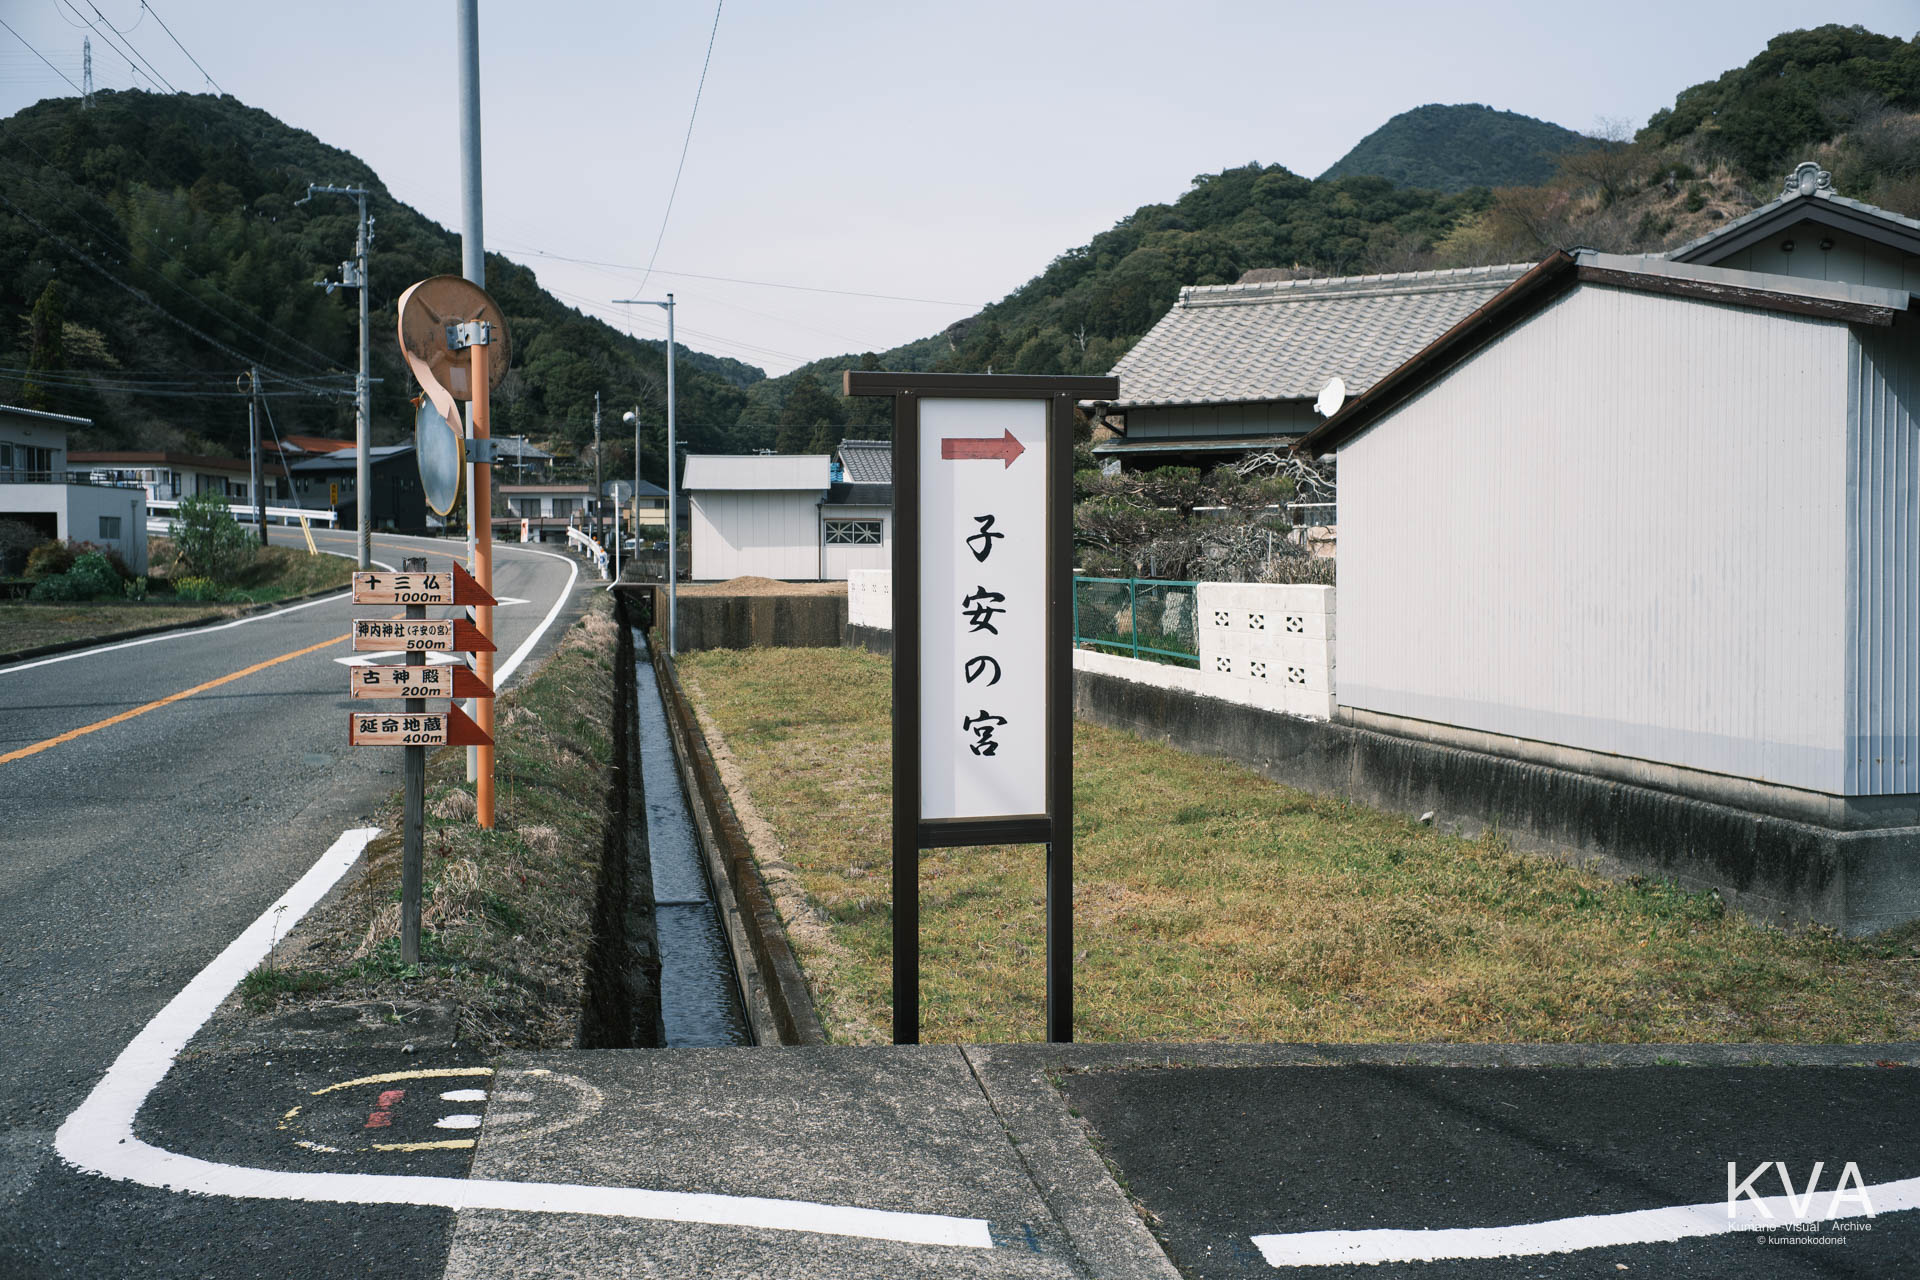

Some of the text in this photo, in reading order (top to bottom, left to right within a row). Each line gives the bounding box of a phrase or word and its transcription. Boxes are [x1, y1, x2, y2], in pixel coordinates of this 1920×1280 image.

[365, 575, 440, 590] 十三仏
[394, 592, 441, 602] 1000m
[962, 514, 1007, 756] 子安の宮
[407, 640, 445, 649] 500m
[363, 669, 439, 684] 古神殿
[401, 687, 440, 696] 200m
[360, 717, 441, 733] 延命地蔵
[403, 734, 442, 743] 400m
